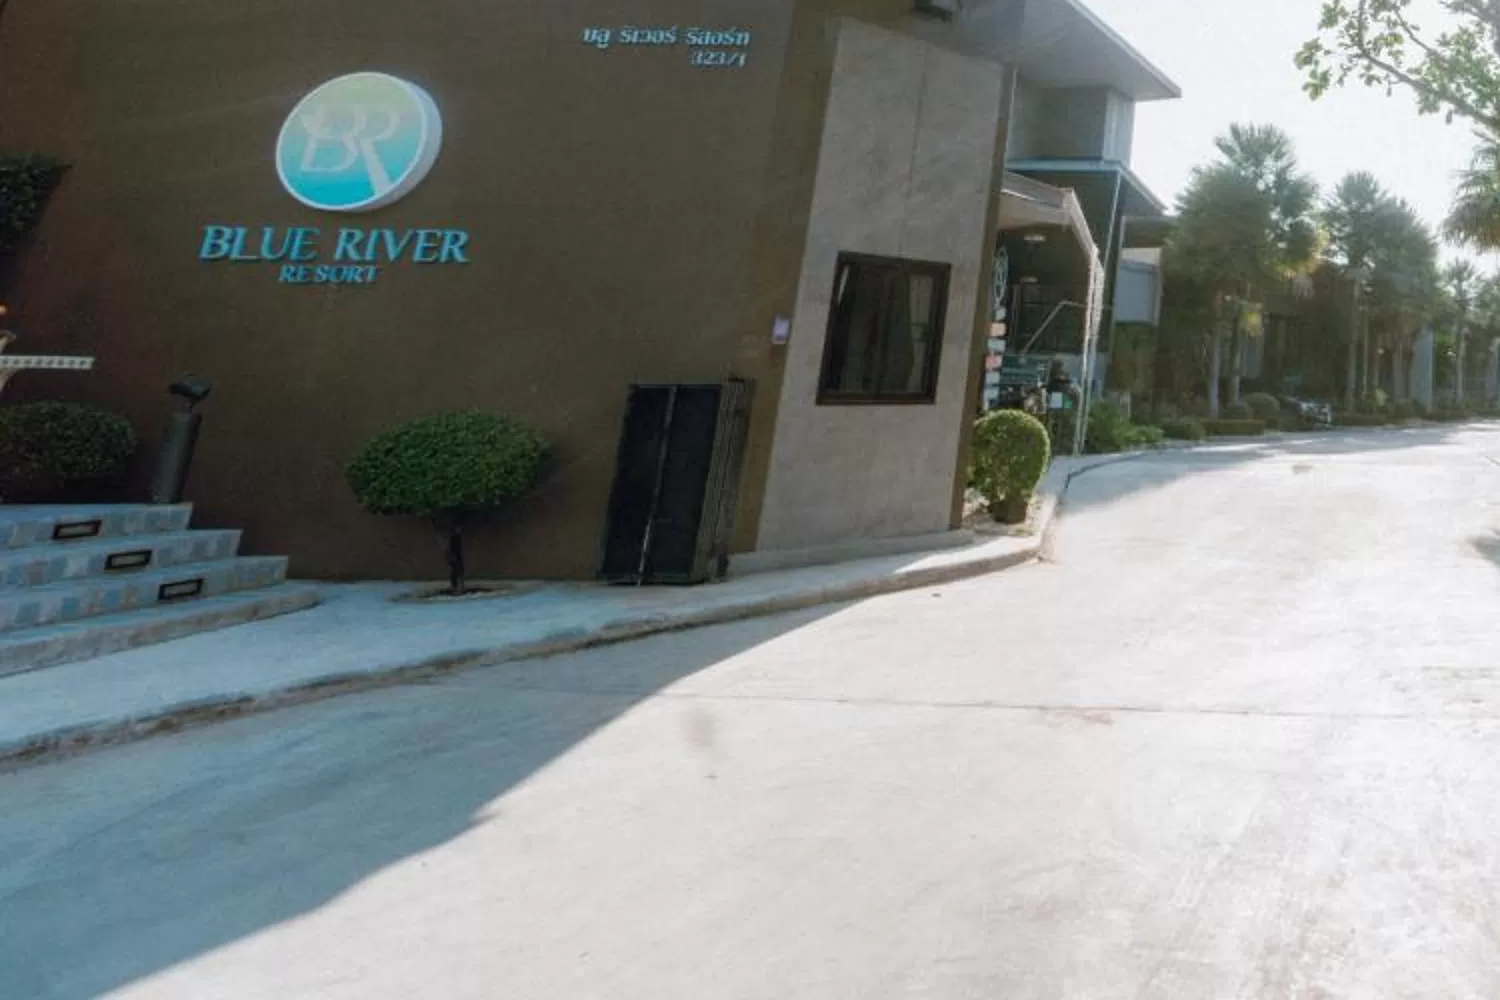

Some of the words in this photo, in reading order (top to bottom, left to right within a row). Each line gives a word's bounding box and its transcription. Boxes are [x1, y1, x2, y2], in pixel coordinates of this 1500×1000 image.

[200, 224, 320, 261] BLUE
[333, 228, 470, 264] RIVER
[278, 263, 380, 283] RESORT
